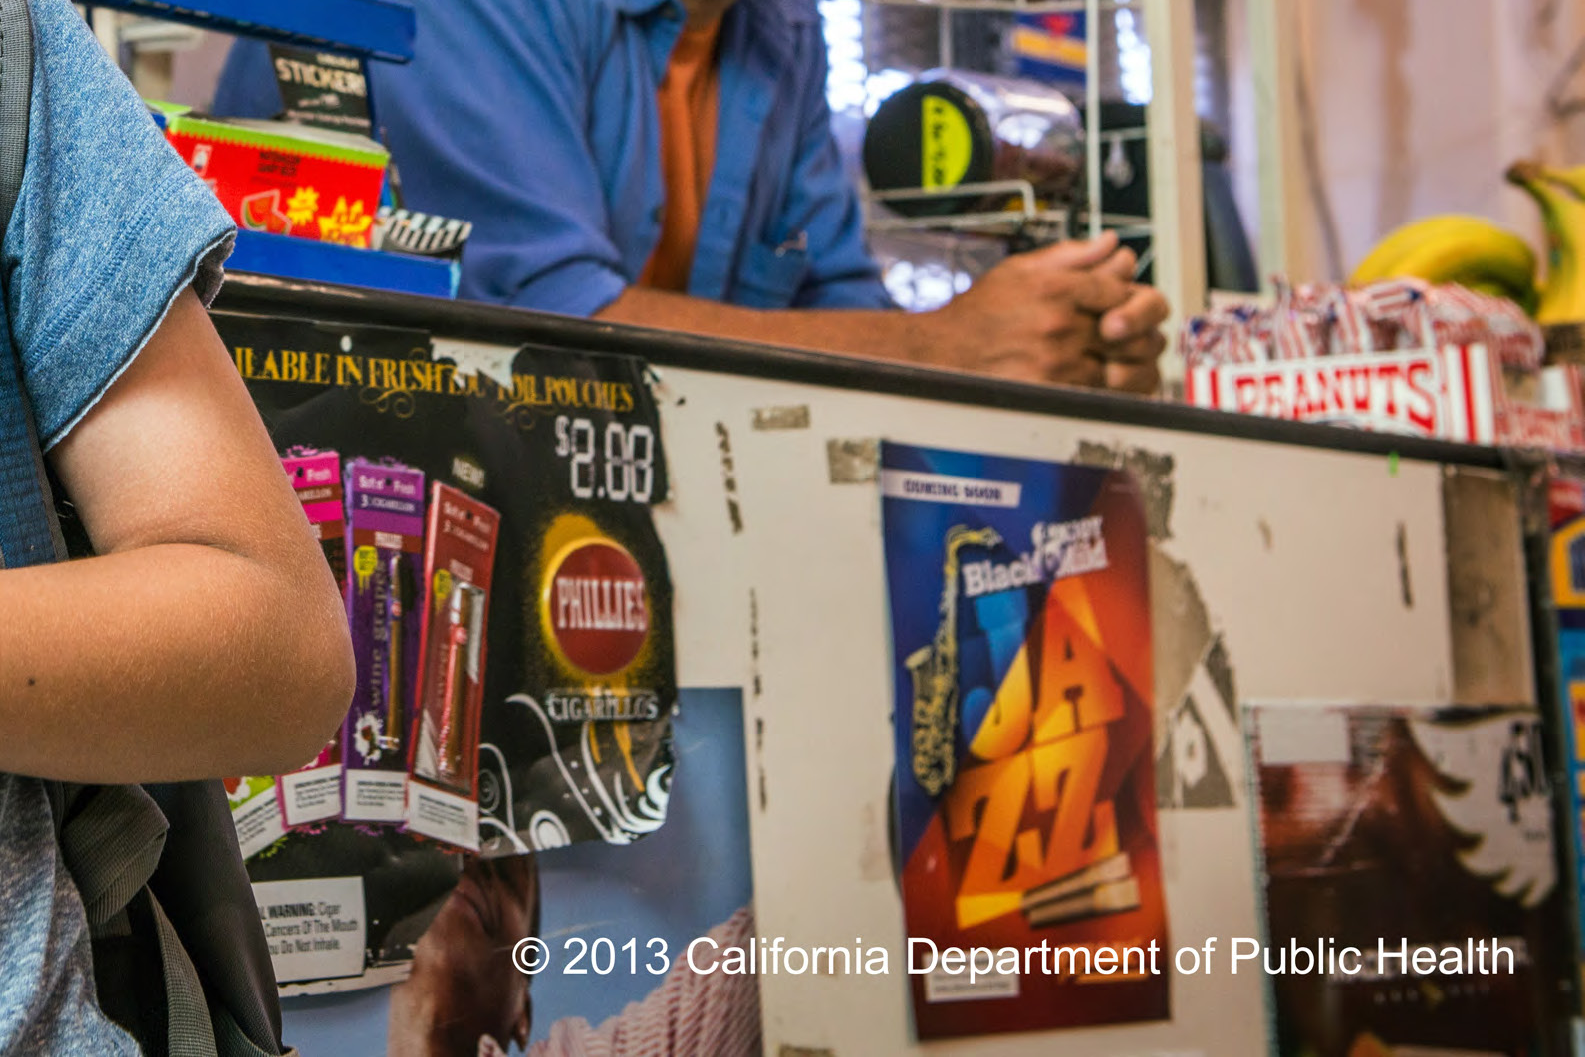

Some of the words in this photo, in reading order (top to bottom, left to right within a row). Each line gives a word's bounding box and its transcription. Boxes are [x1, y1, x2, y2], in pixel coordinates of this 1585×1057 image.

[335, 354, 364, 387] IN
[369, 357, 443, 394] FRESH
[1235, 361, 1435, 432] PEANUTS
[903, 477, 960, 498] COMING
[962, 552, 1044, 598] Black
[555, 577, 648, 632] PHILLIES
[280, 939, 294, 954] Do
[295, 938, 311, 953] Not
[313, 919, 330, 934] The
[331, 918, 358, 932] Mouth
